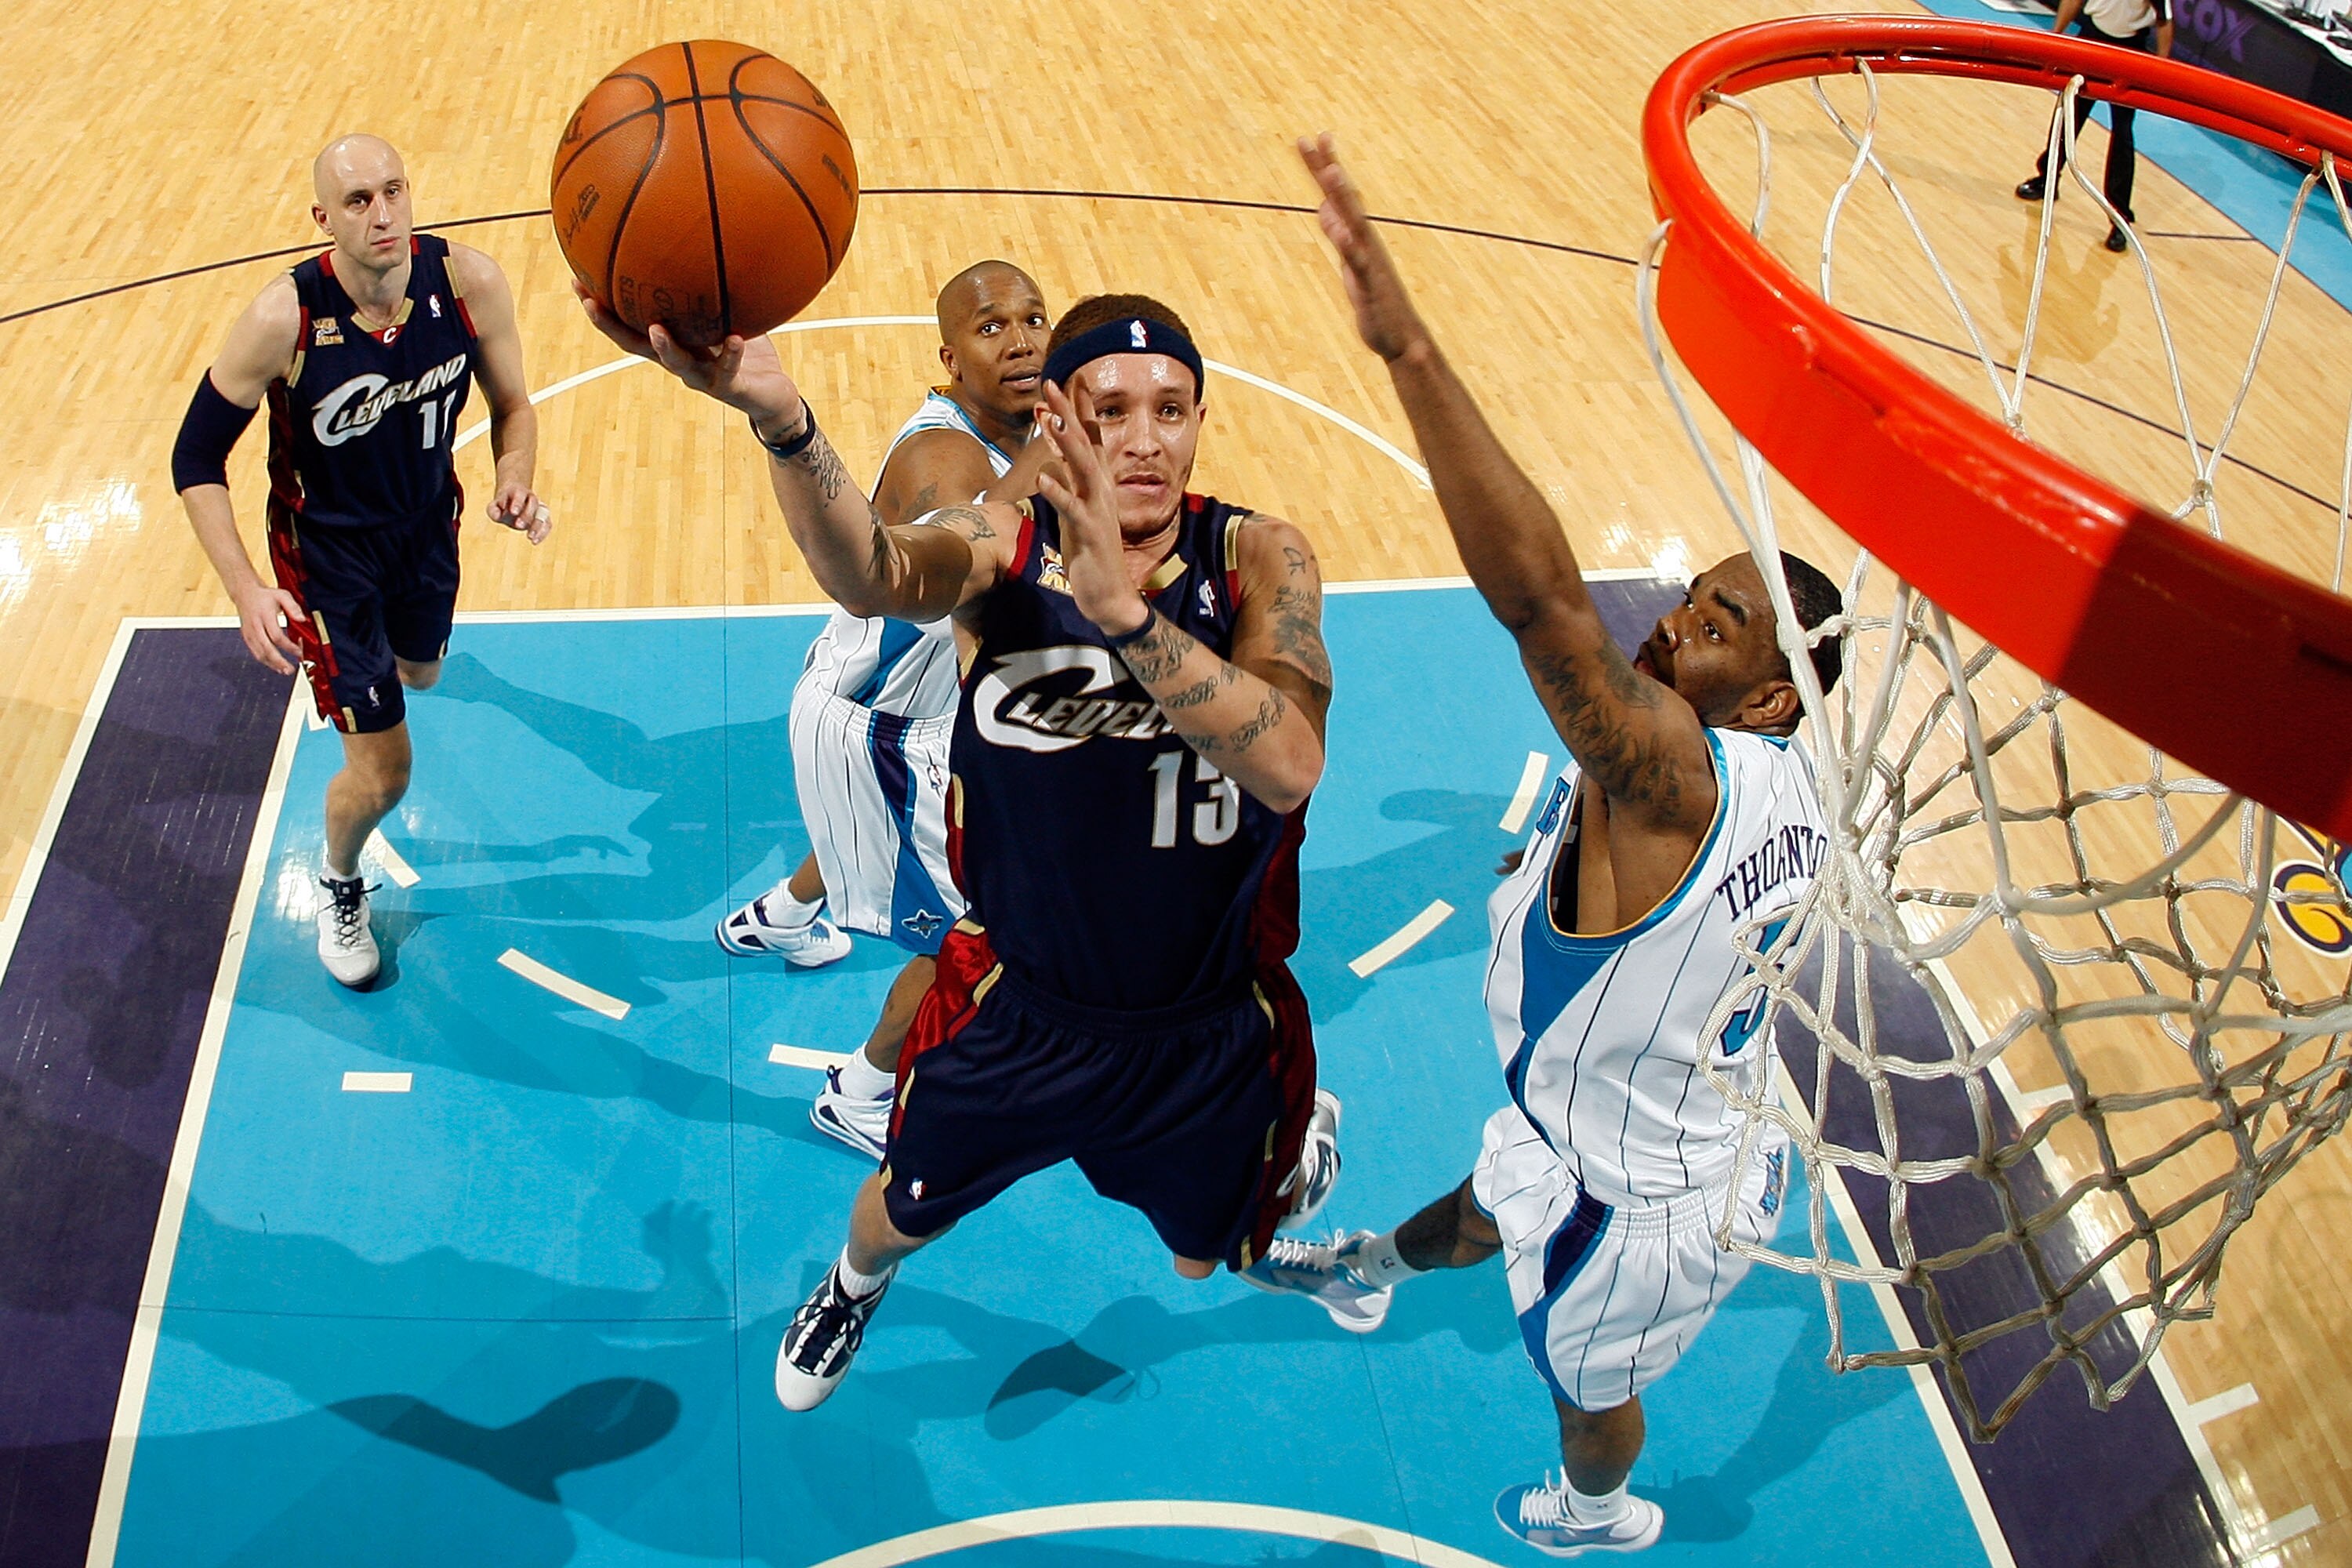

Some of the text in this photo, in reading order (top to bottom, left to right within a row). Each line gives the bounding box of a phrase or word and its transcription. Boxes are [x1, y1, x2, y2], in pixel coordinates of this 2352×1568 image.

[310, 353, 467, 447] CLEVELAND
[972, 644, 1176, 753] CLEVEL
[1147, 750, 1240, 849] 13
[1715, 824, 1828, 922] THORNTO
